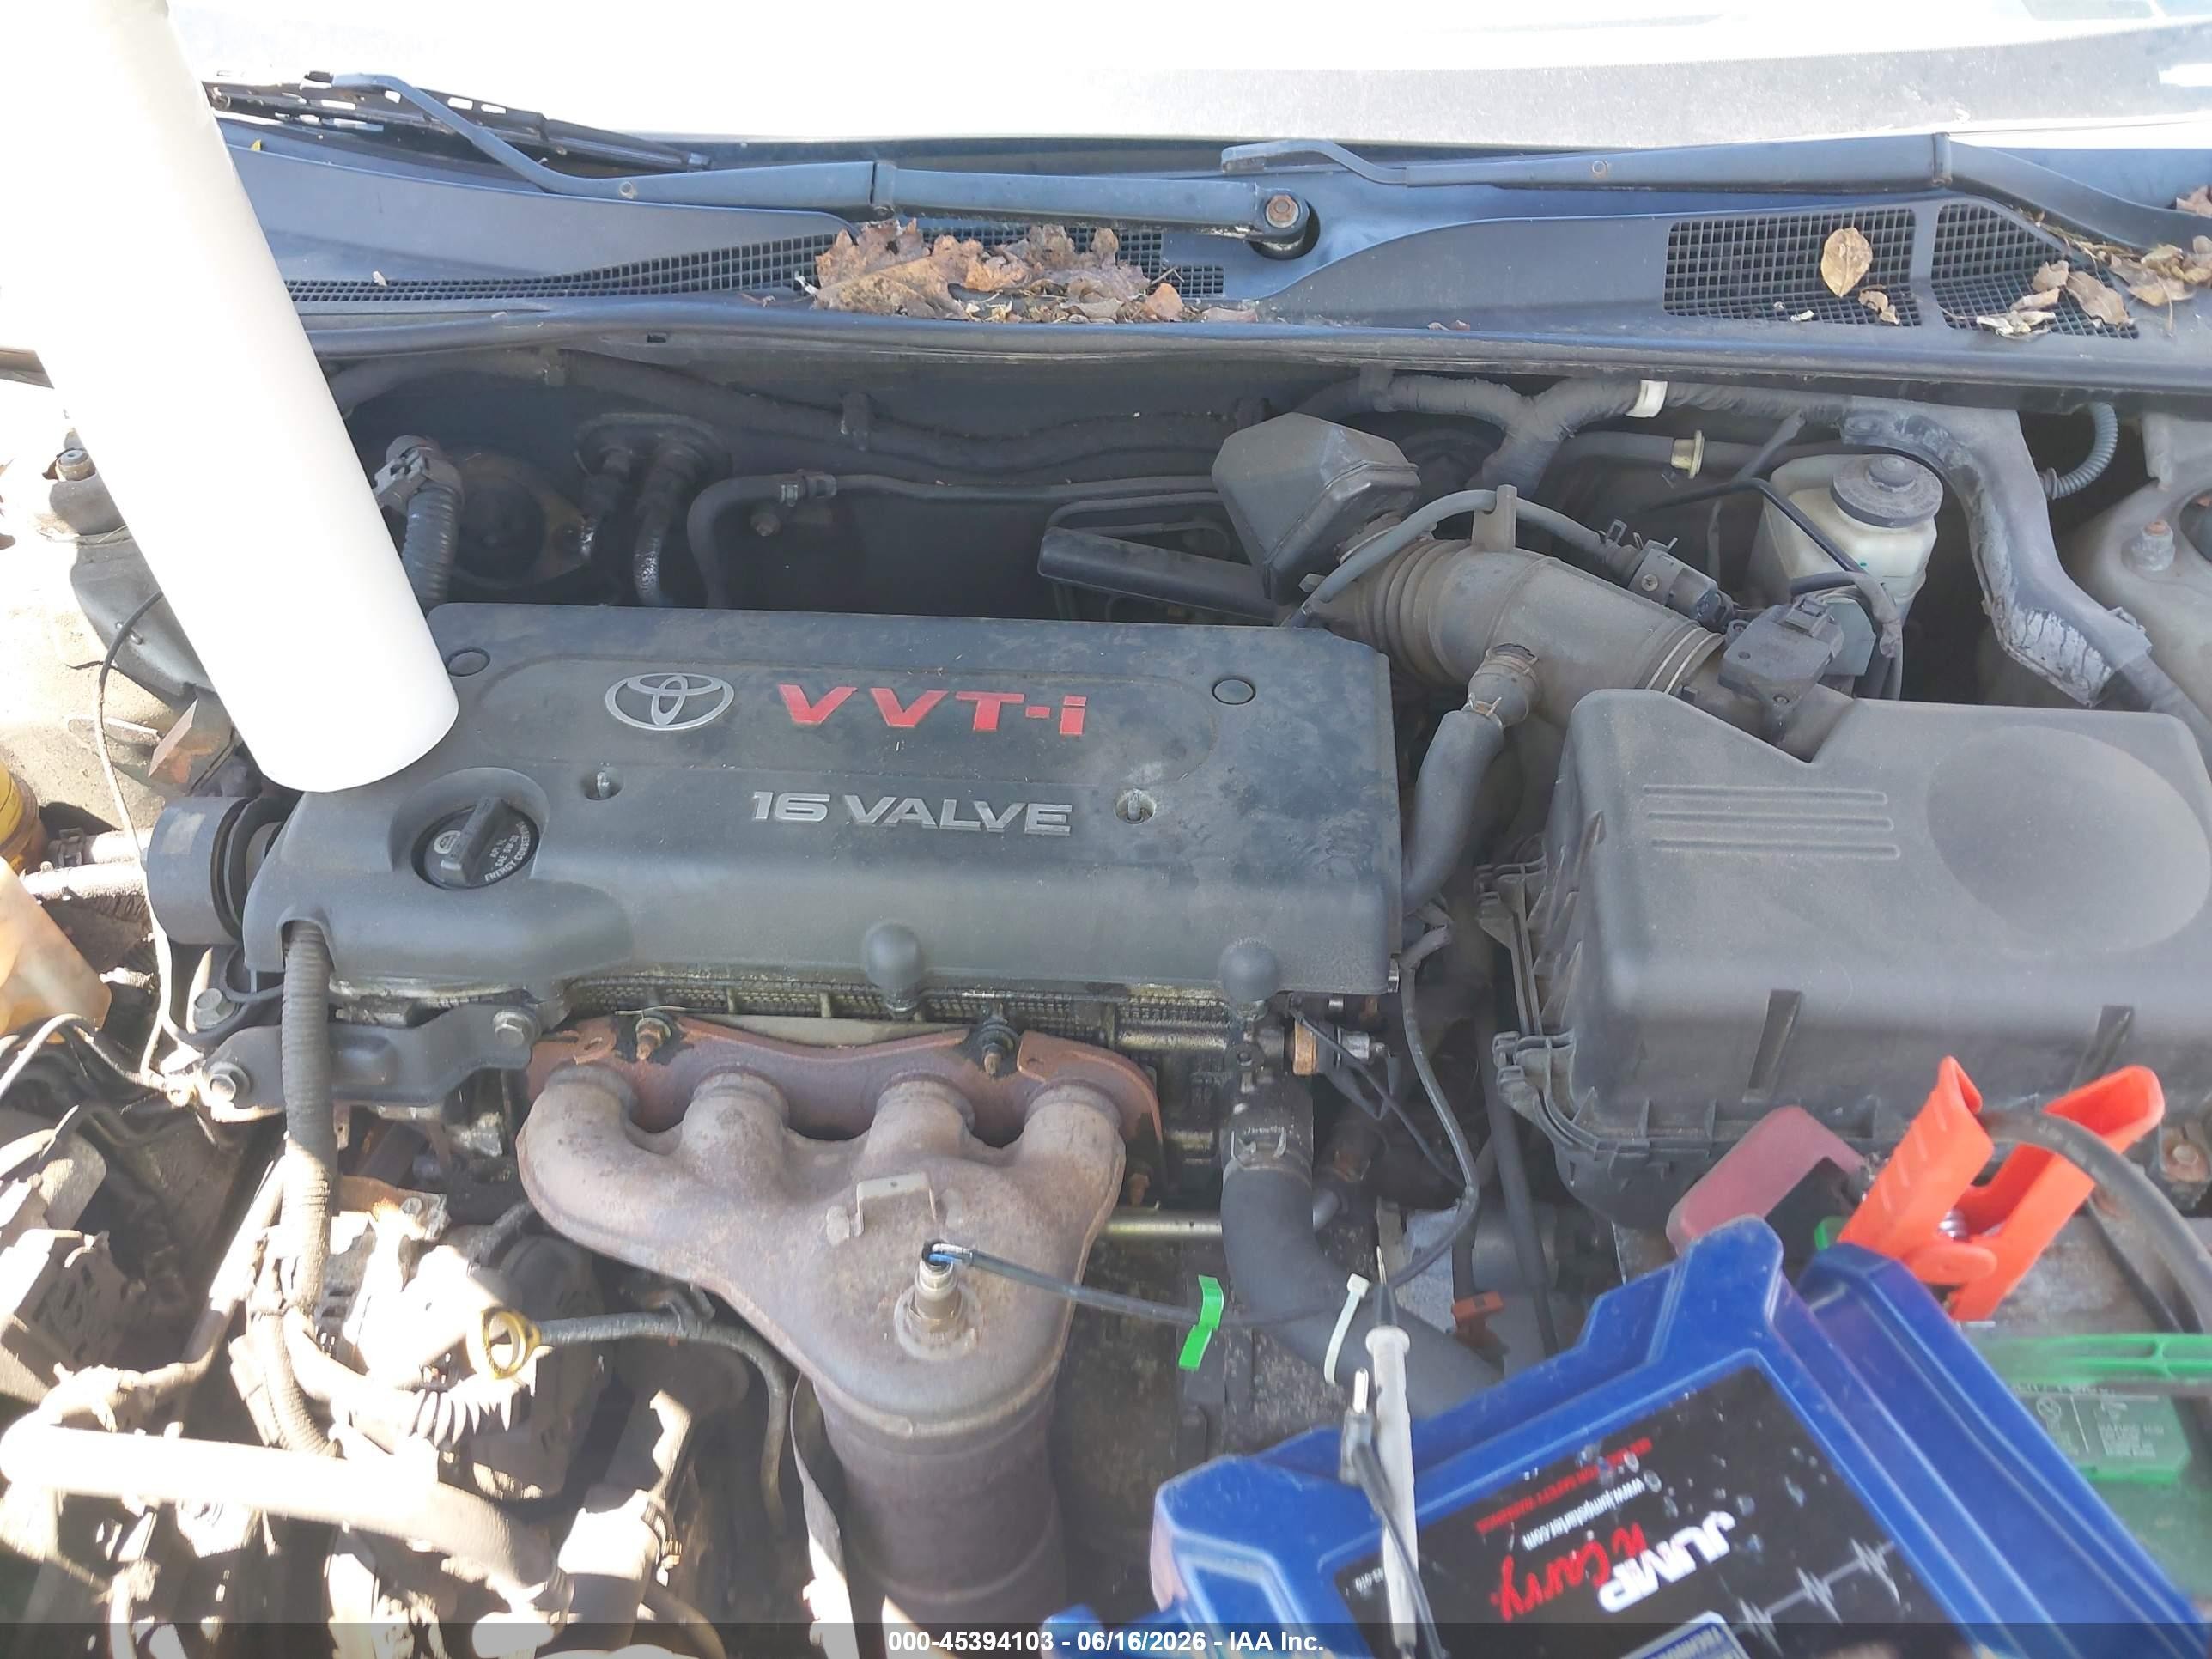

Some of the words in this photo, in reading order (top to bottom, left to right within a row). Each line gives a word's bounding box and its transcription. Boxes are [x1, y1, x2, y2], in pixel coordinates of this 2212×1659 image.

[778, 684, 1087, 735] VVT-i
[752, 790, 831, 823] 16
[844, 794, 1073, 836] VALVE
[484, 860, 517, 882] ENERGY
[1598, 1510, 1735, 1613] JUMP
